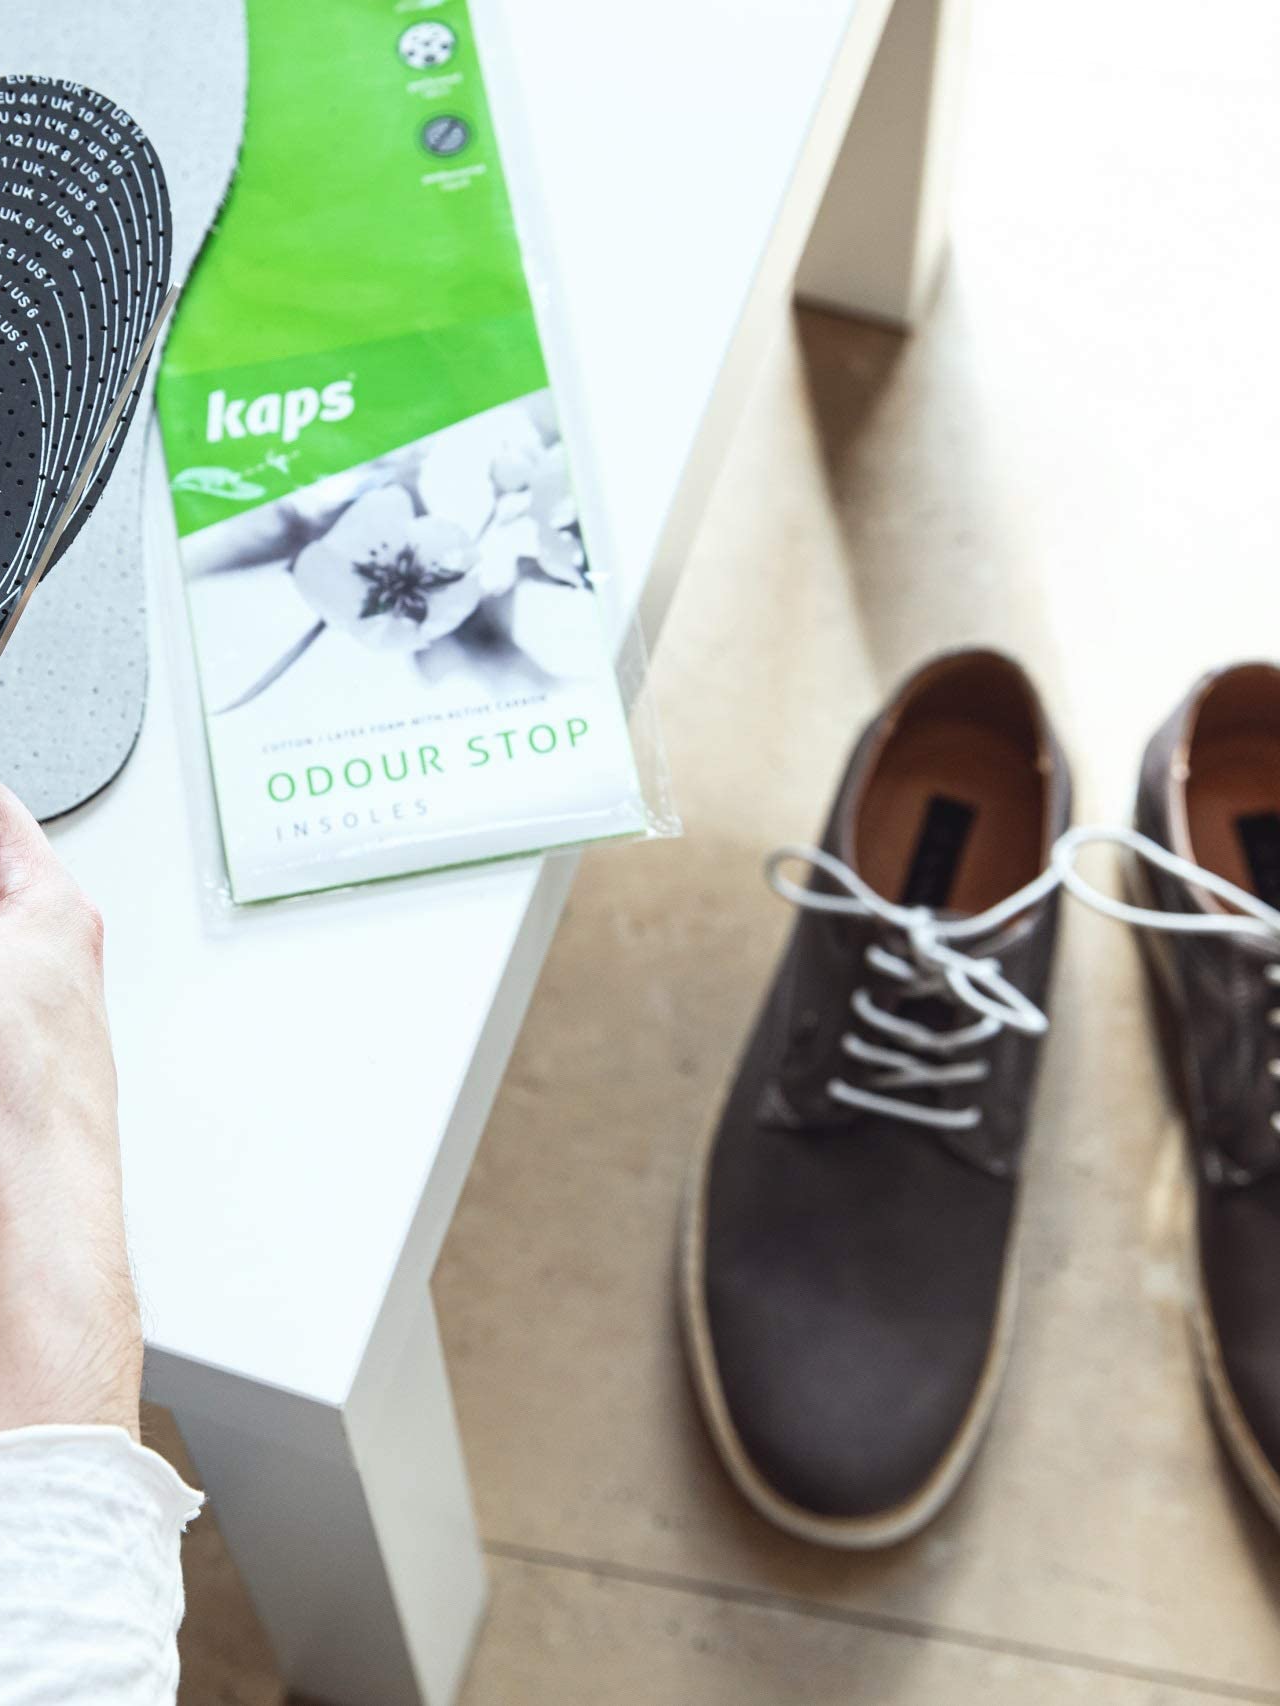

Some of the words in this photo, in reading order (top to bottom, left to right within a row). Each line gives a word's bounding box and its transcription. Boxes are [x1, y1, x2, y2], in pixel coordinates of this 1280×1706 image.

[20, 93, 38, 106] 44
[51, 96, 74, 113] UK
[78, 107, 95, 123] 10
[120, 144, 134, 160] 11
[62, 80, 84, 97] UK
[88, 91, 103, 107] 11
[110, 109, 131, 127] US
[131, 125, 147, 142] 12
[6, 134, 23, 147] 42
[36, 138, 60, 156] UK
[61, 150, 71, 162] 8
[80, 162, 100, 183] US
[96, 183, 108, 194] 9
[14, 112, 32, 126] 43
[69, 128, 80, 140] 9
[87, 141, 108, 161] US
[107, 159, 123, 175] 10
[12, 183, 34, 200] UK
[40, 192, 48, 201] 7
[56, 205, 77, 226] US
[73, 225, 84, 236] 9
[22, 160, 45, 177] UK
[66, 182, 87, 202] US
[85, 200, 97, 211] 8
[0, 207, 23, 225] UK
[25, 218, 35, 229] 6
[43, 229, 64, 250] US
[62, 248, 74, 259] 8
[6, 247, 16, 259] 5
[26, 258, 47, 279] US
[44, 278, 56, 287] 7
[10, 287, 31, 308] US
[26, 308, 39, 318] 6
[0, 320, 20, 341] US
[16, 341, 29, 351] 5
[206, 380, 355, 443] kaps
[267, 745, 445, 802] ODOUR
[468, 718, 588, 767] STOP
[275, 800, 428, 841] INSOLES
